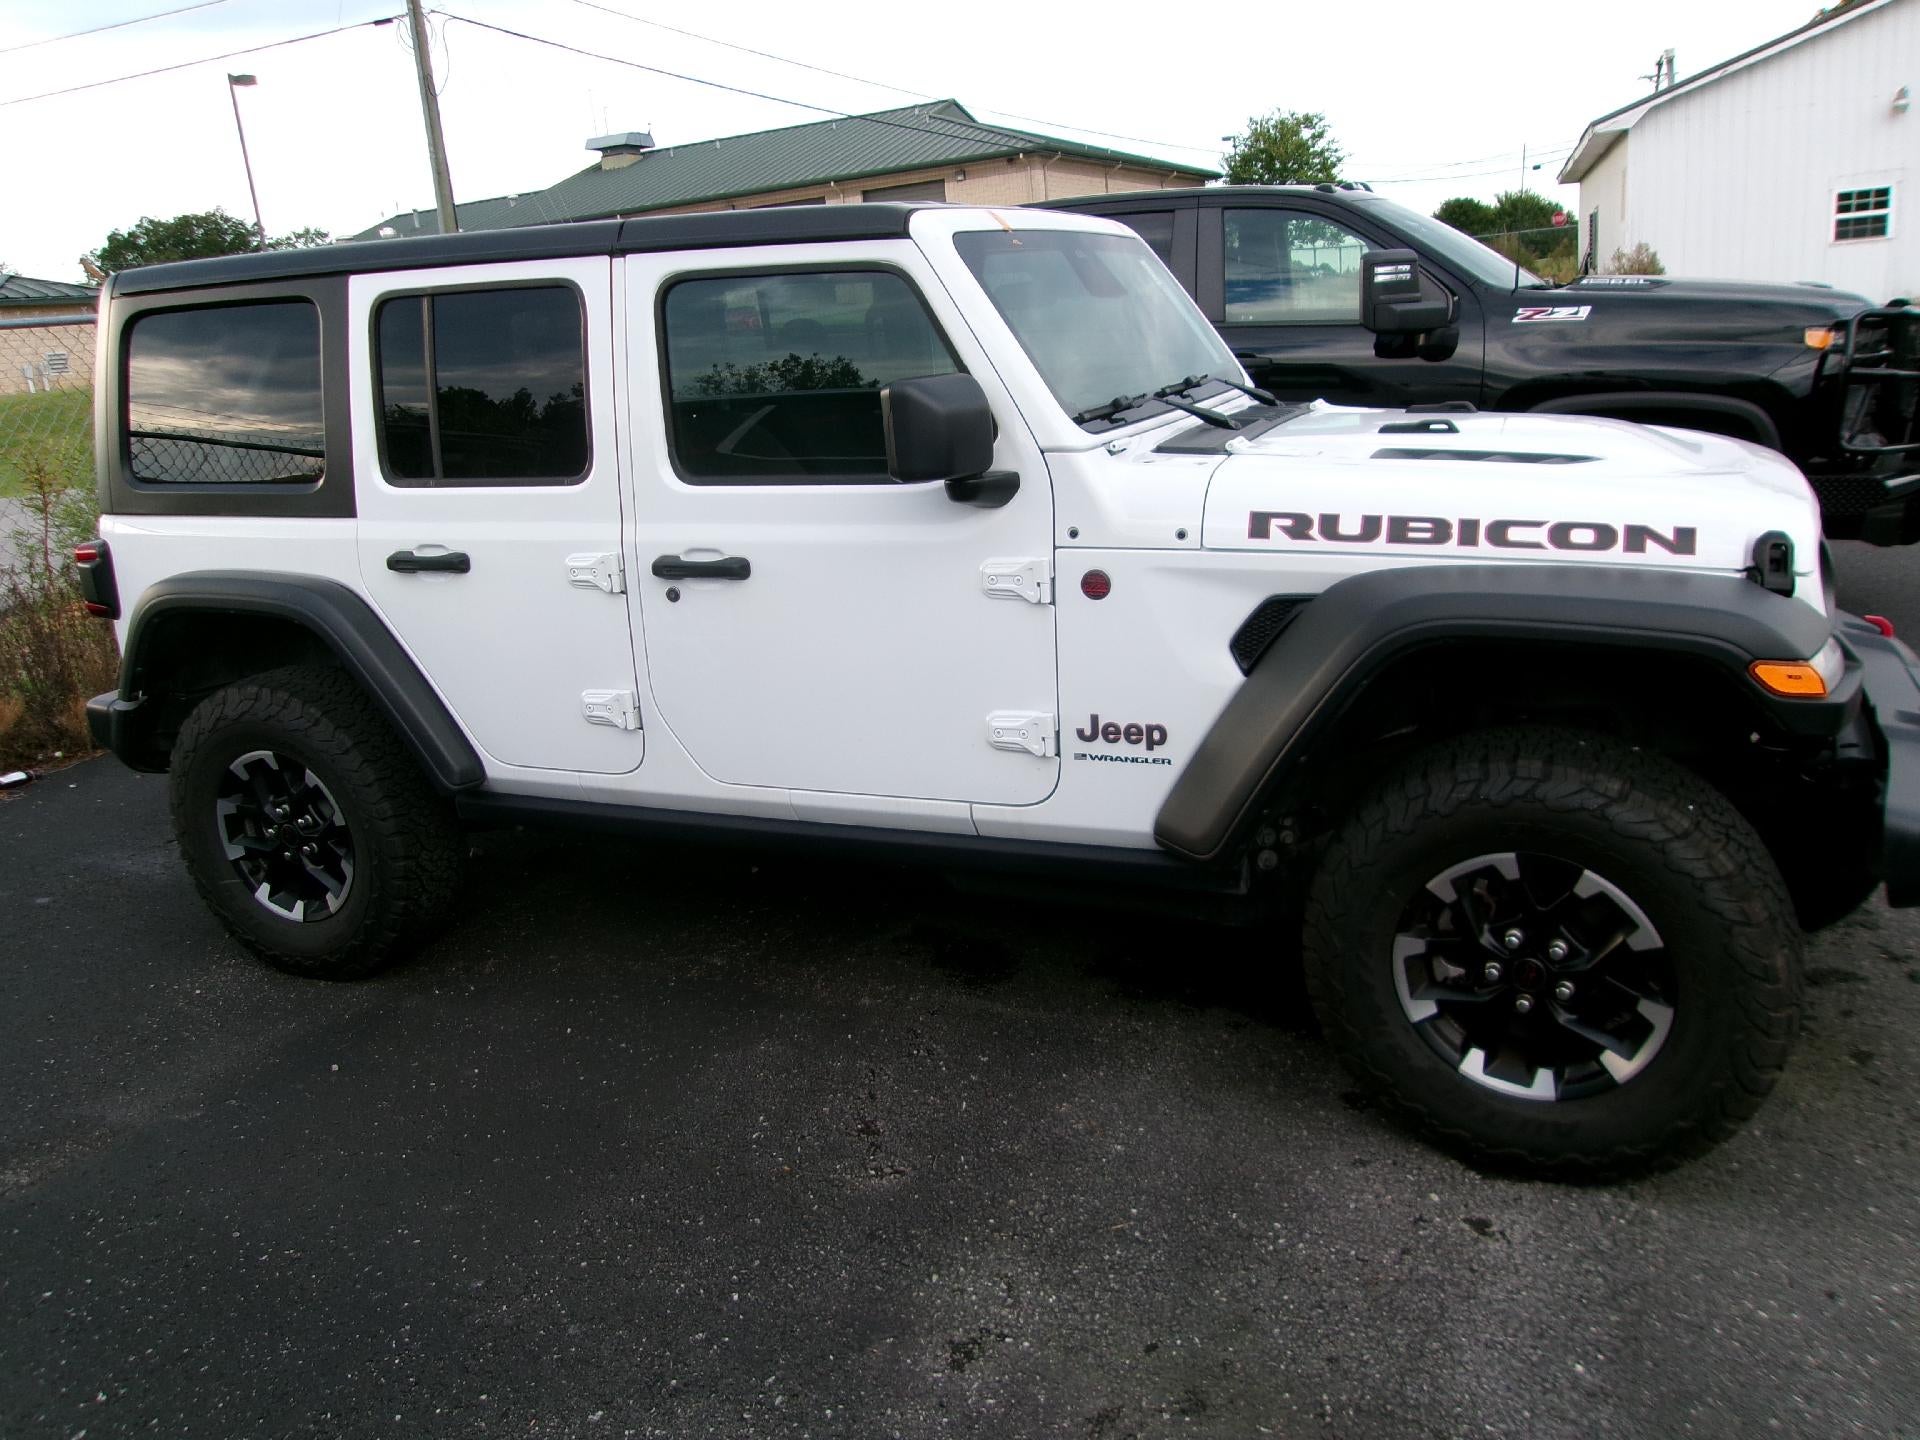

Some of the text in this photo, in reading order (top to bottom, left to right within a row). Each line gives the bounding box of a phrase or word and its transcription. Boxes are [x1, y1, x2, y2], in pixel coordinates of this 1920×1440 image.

[1248, 510, 1697, 556] RUBICON
[1076, 713, 1168, 751] Jeep
[1088, 753, 1172, 765] WRANGLER
